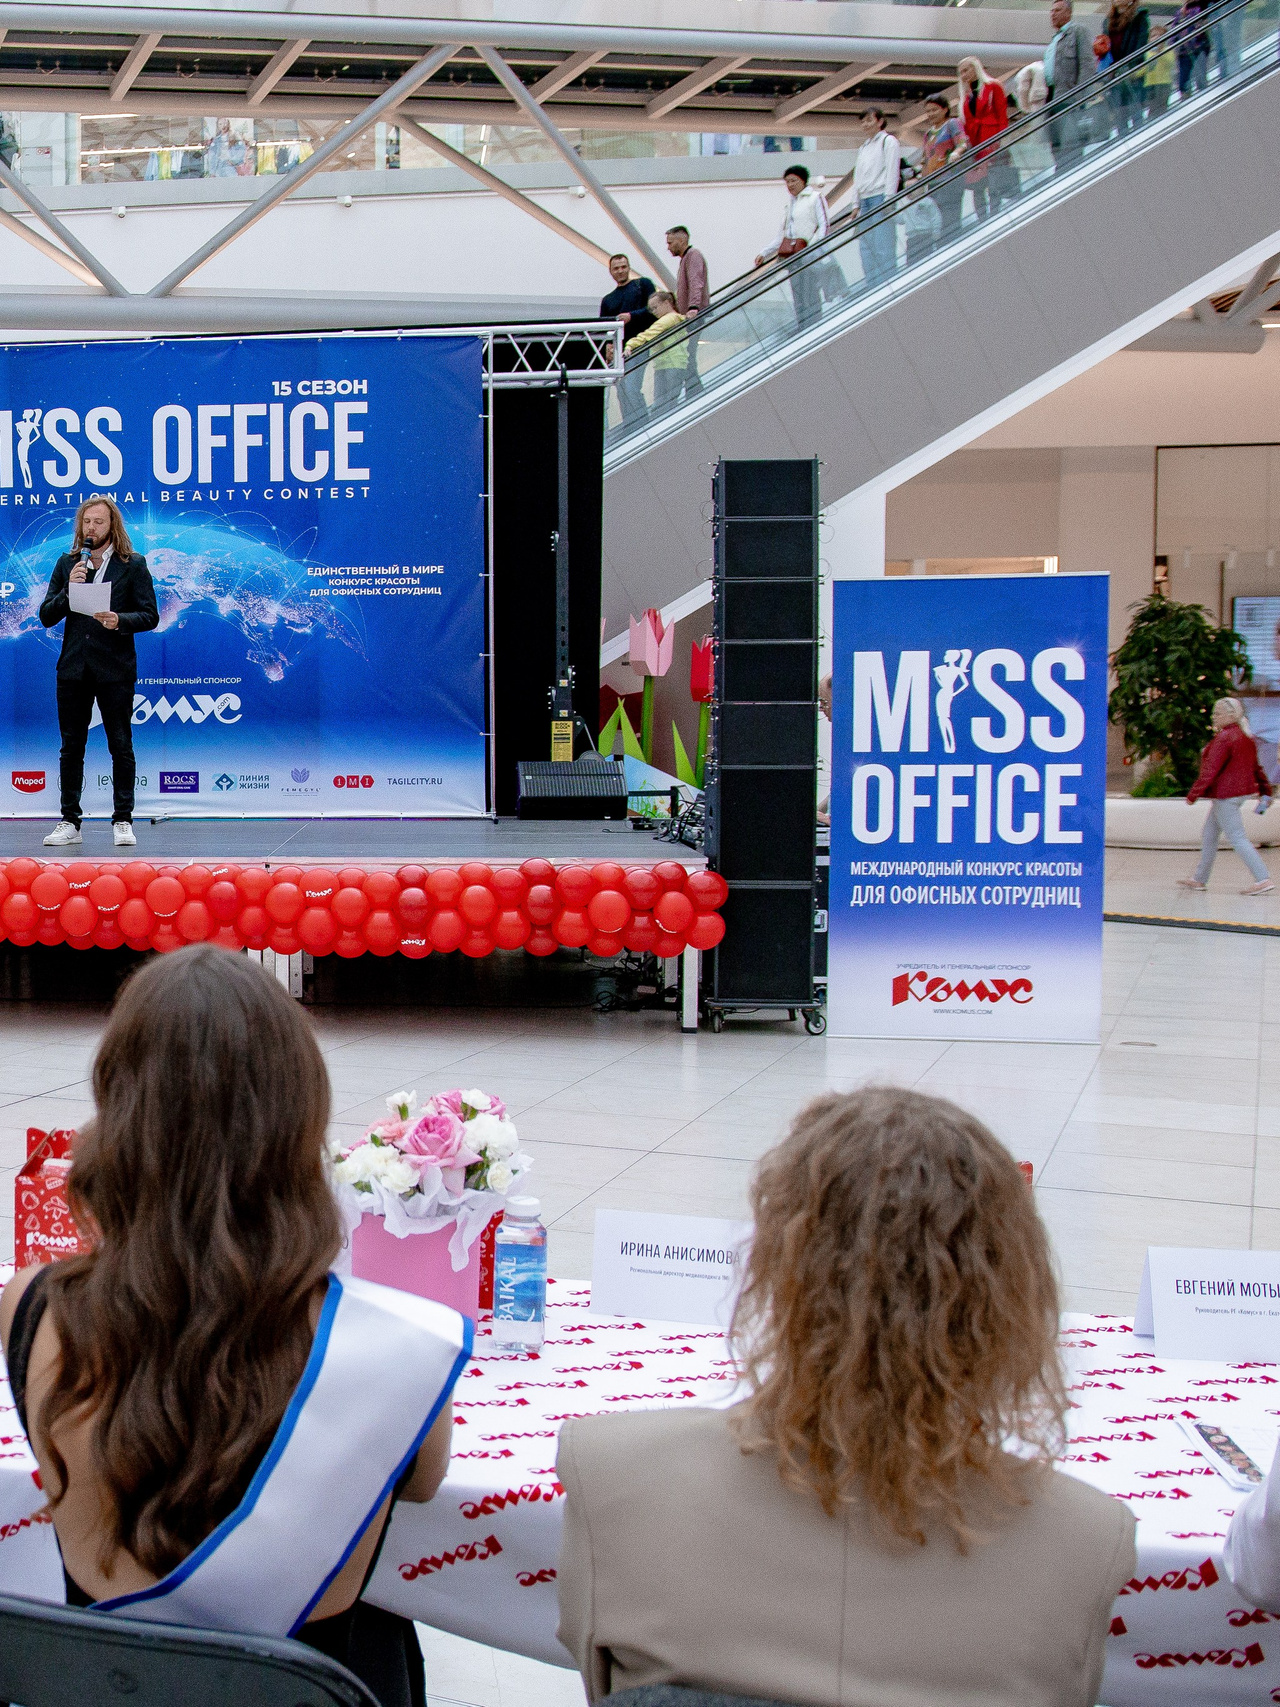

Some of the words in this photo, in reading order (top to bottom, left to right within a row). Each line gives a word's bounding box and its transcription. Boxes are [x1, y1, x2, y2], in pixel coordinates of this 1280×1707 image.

[271, 380, 292, 396] 15
[296, 379, 369, 396] СЕЗОН
[152, 401, 370, 485] OFFICE
[160, 488, 252, 502] BEAUTY
[263, 486, 370, 500] CONTEST
[307, 564, 400, 577] ЕДИНСТВЕННЫЙ
[402, 565, 410, 575] В
[412, 565, 445, 575] МИРЕ
[328, 578, 373, 586] КОНКУРС
[374, 577, 420, 586] КРАСОТЫ
[310, 588, 330, 597] ДЛЯ
[331, 587, 381, 596] ОФИСНЫХ
[383, 587, 442, 596] СОТРУДНИЦ
[144, 677, 201, 685] ГЕНЕРАЛЬНЫЙ
[203, 677, 242, 685] СПОНСОР
[853, 647, 1086, 754] MISS
[88, 693, 242, 730] омус
[14, 776, 44, 787] Maped
[238, 782, 270, 790] ЖИЗНИ
[386, 777, 443, 785] TAGILCITY.RU
[851, 762, 1083, 845] OFFICE
[850, 860, 963, 877] МЕЖДУНАРОДНЫЙ
[966, 862, 1023, 876] КОНКУРС
[1025, 861, 1083, 877] КРАСОТЫ
[850, 885, 885, 907] ДЛЯ
[890, 885, 977, 905] ОФИСНЫХ
[980, 885, 1081, 908] СОТРУДНИЦ
[892, 970, 1034, 1007] Комус
[620, 1241, 661, 1259] ИРИНА
[498, 1256, 517, 1321] BAIKAL
[1175, 1278, 1236, 1297] ЕВГЕНИЙ
